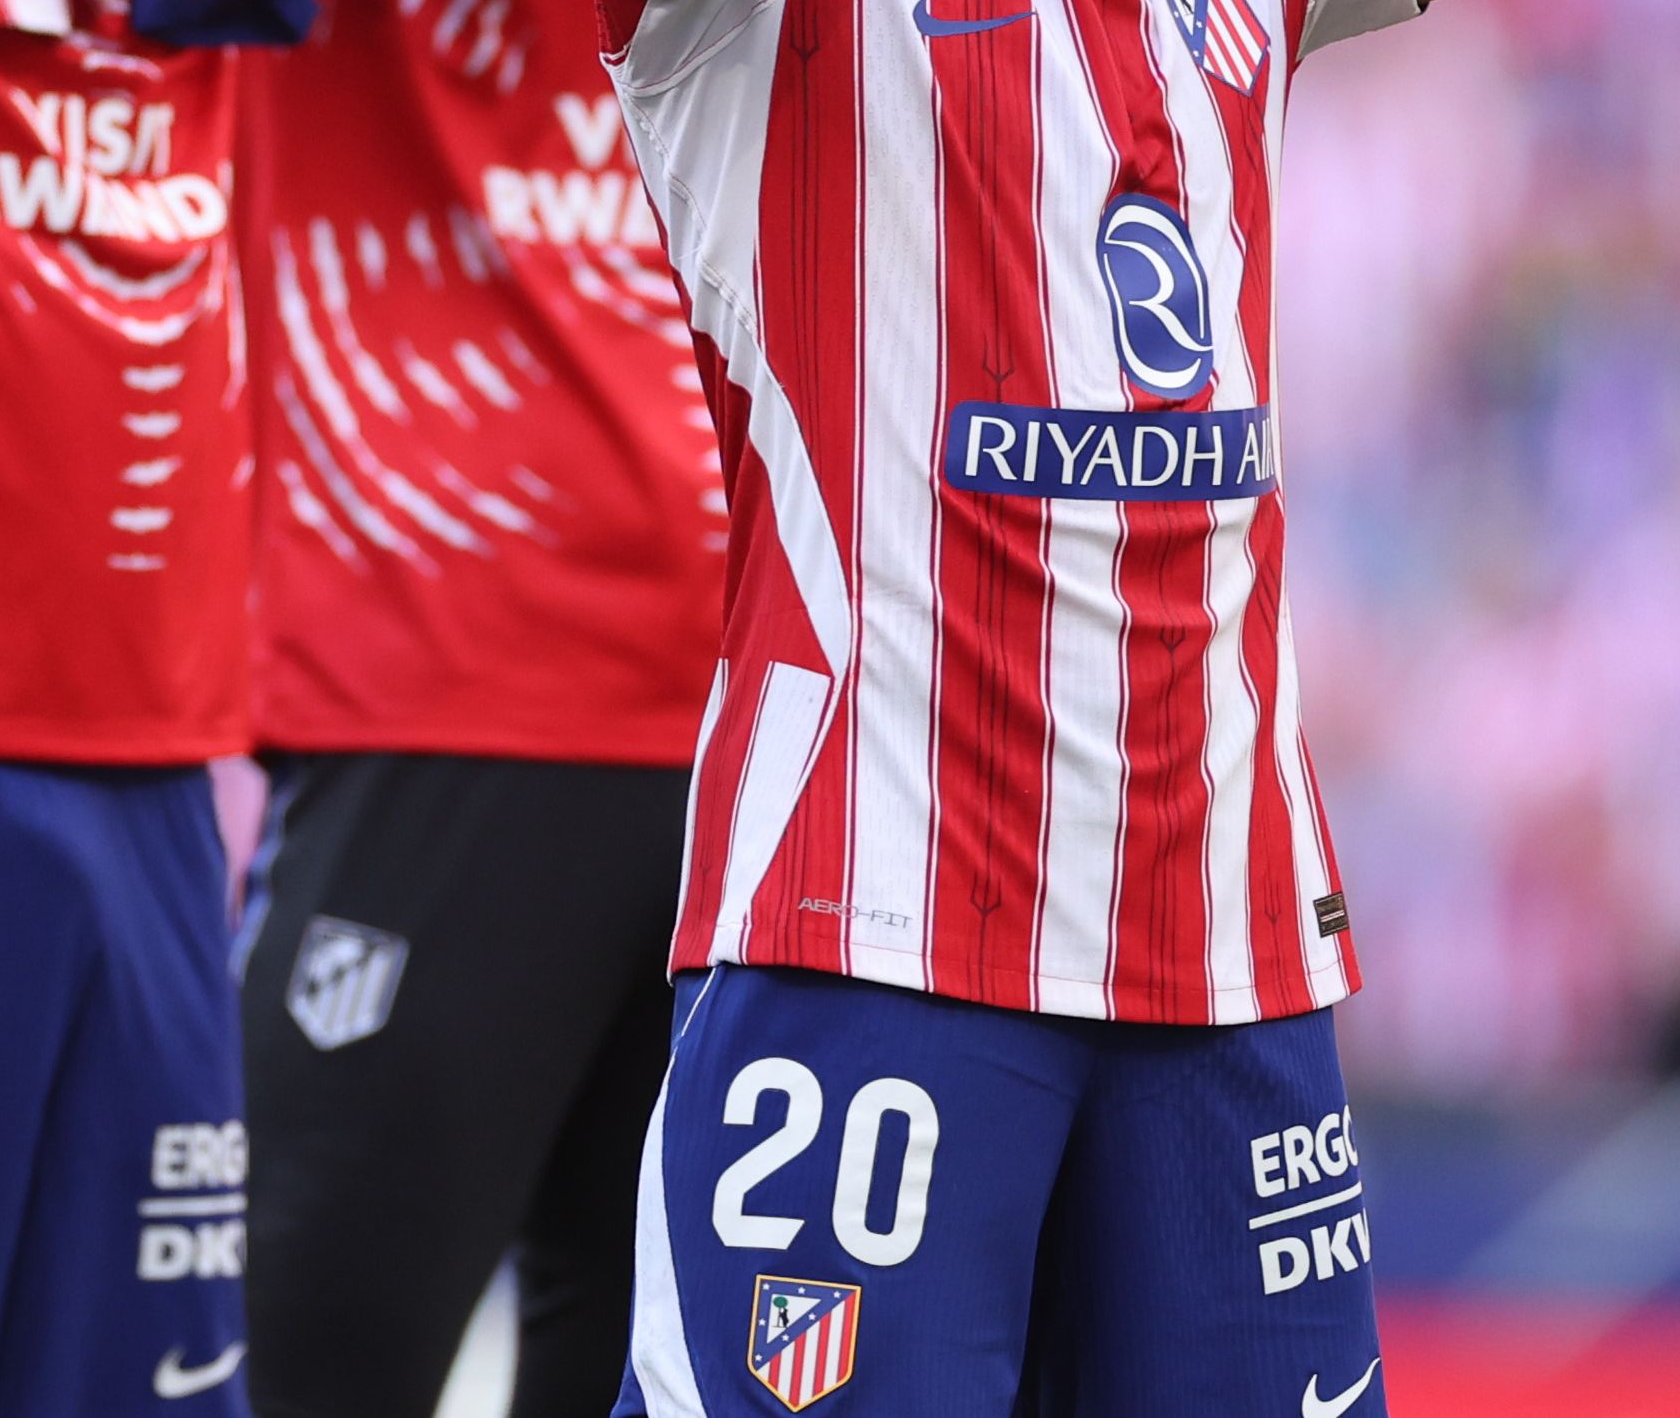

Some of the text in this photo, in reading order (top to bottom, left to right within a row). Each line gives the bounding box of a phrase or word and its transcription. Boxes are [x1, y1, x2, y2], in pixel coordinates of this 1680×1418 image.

[963, 415, 1224, 487] RIYADH
[797, 896, 913, 929] AERO-FIT
[150, 1118, 249, 1191] ERG
[712, 1056, 941, 1268] 20
[136, 1219, 247, 1281] DK
